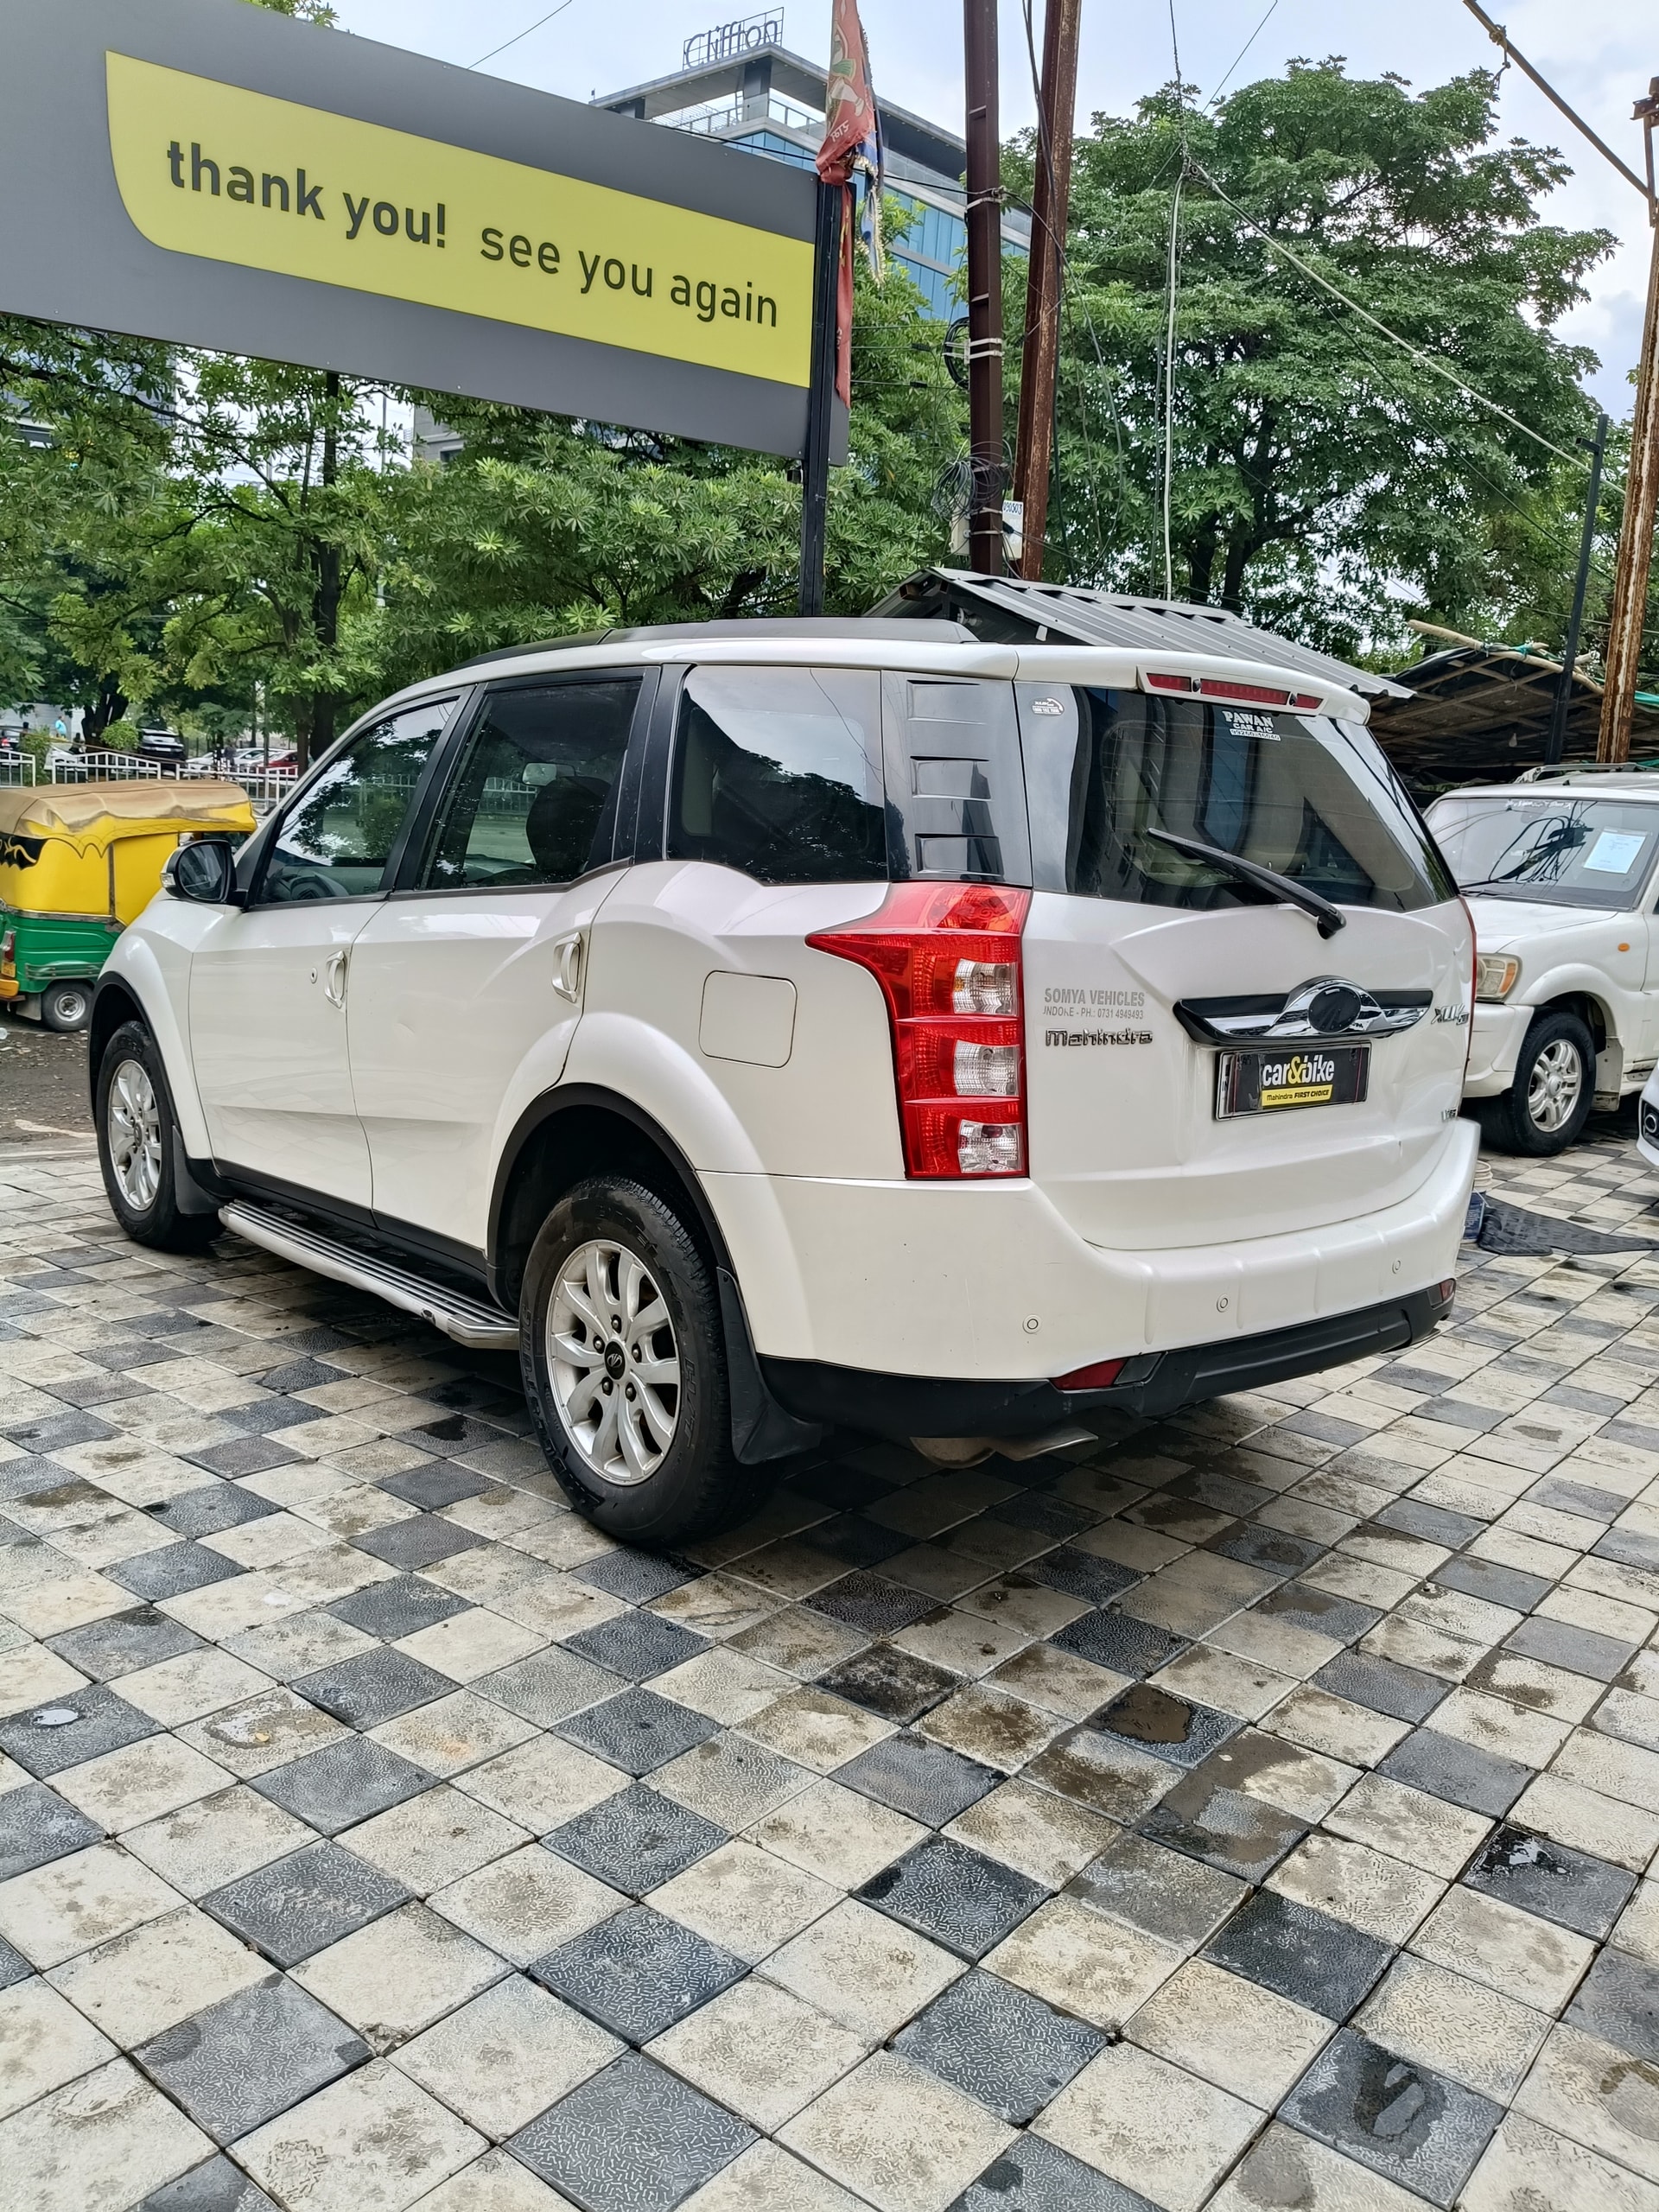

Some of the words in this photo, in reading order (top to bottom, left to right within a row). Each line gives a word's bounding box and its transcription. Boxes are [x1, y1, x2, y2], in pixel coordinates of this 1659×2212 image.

[167, 141, 326, 221] thank
[342, 192, 446, 249] you!
[480, 227, 561, 275] see
[578, 251, 653, 298] you
[671, 275, 778, 327] again
[1222, 710, 1274, 728] PAWAN
[1232, 722, 1255, 731] CAR
[1044, 988, 1086, 1004] SOMYA
[1090, 989, 1145, 1007] VEHICLES
[1097, 1008, 1113, 1018] 0731
[1115, 1009, 1144, 1020] 4949493
[1046, 1027, 1154, 1046] Mahindra
[1262, 1054, 1335, 1086] car&bike
